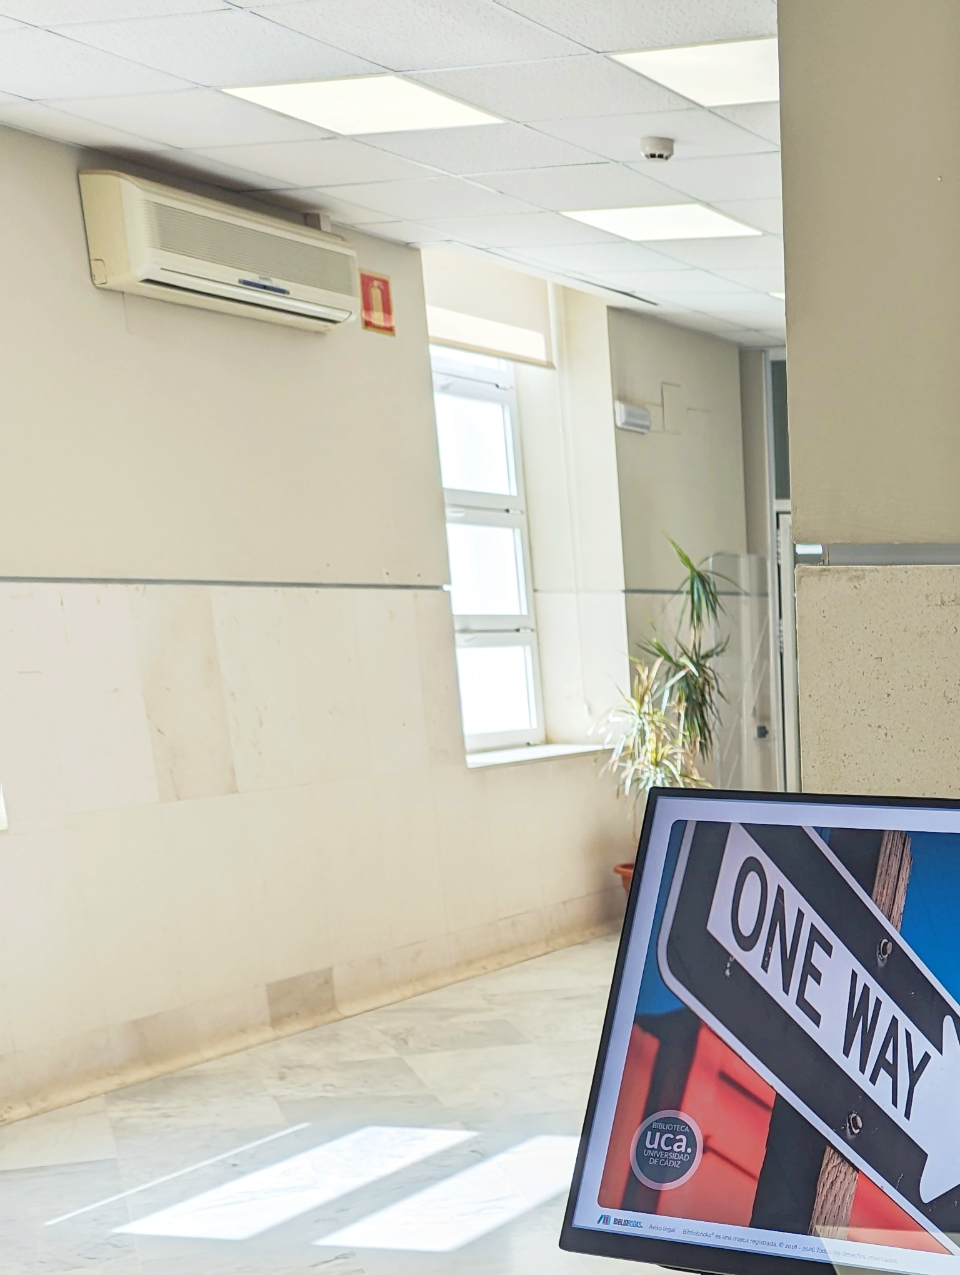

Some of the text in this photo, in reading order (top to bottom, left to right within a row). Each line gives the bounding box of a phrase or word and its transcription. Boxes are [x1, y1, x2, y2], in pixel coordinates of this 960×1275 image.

[731, 856, 932, 1121] ONE WAY
[652, 1122, 690, 1132] BIBLIOTECA
[643, 1149, 690, 1161] UNIVERSIDAD
[649, 1157, 658, 1165] DE
